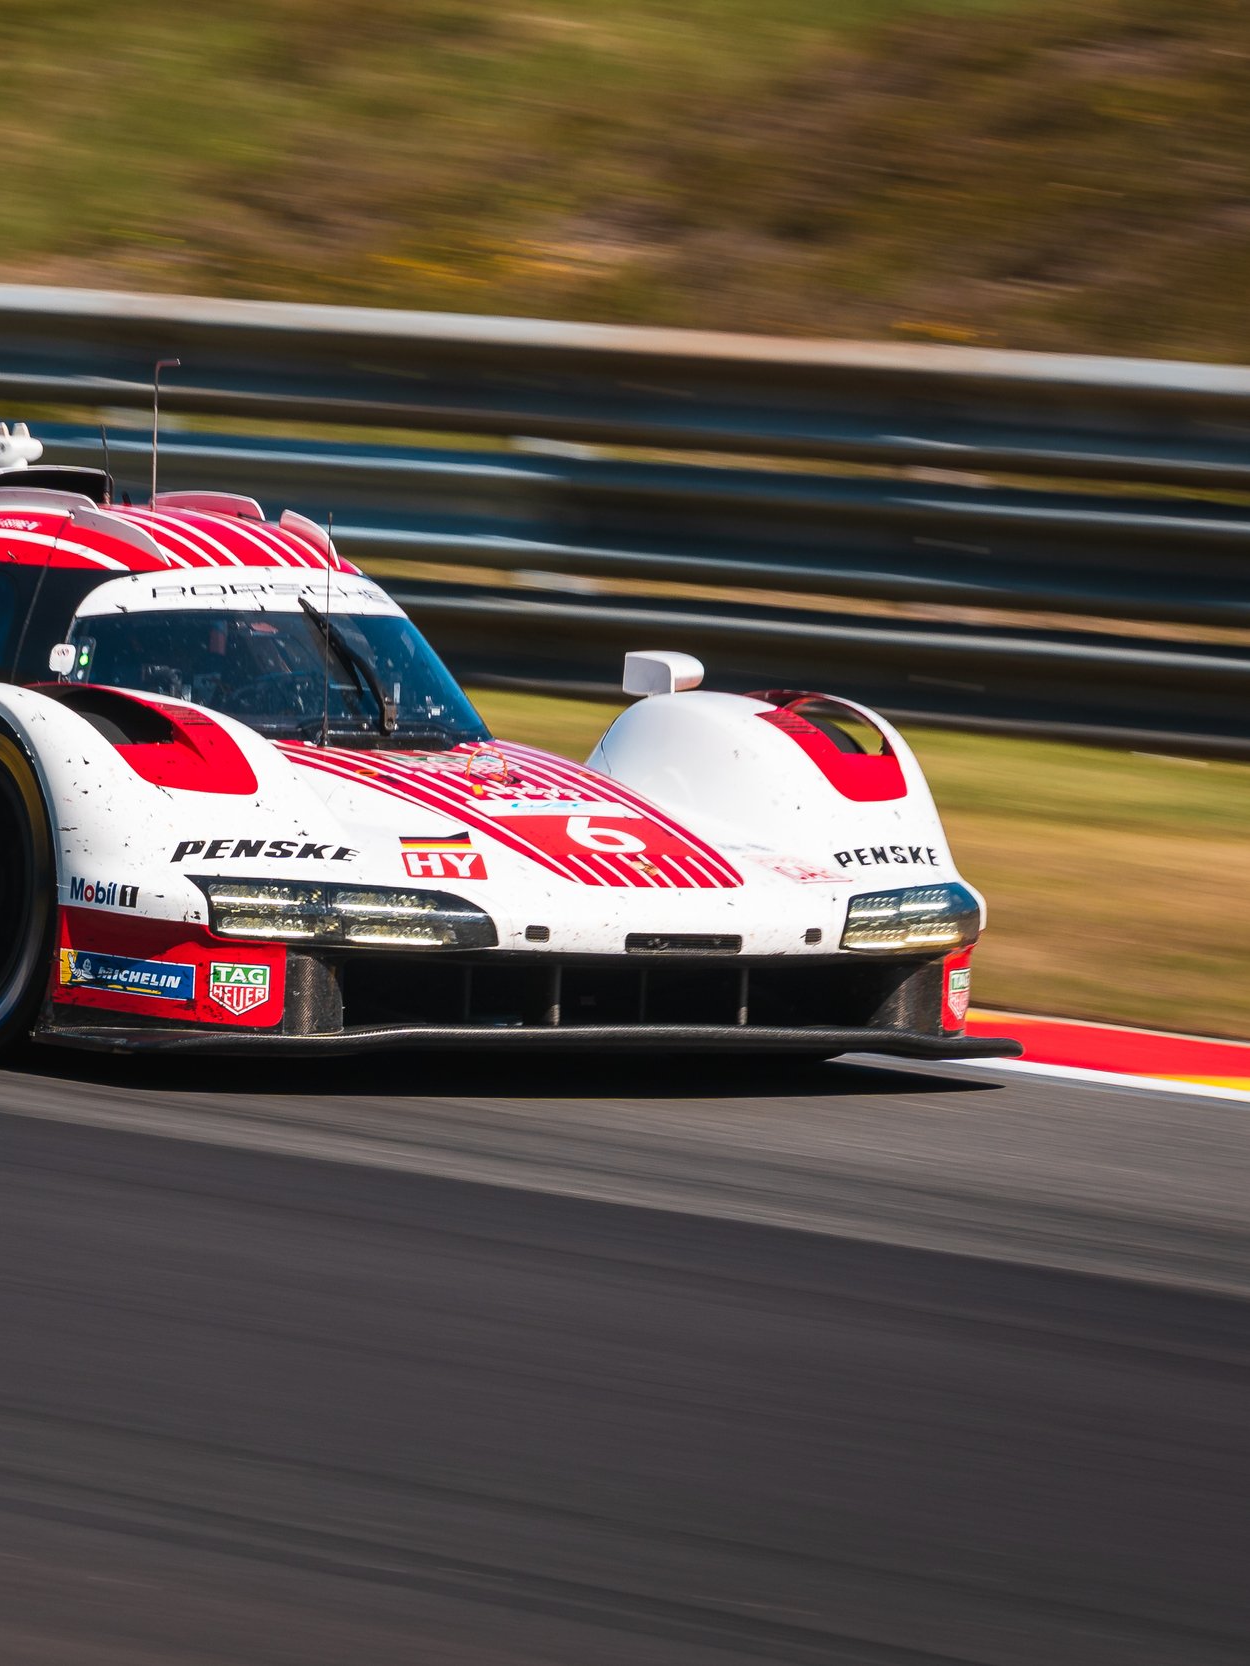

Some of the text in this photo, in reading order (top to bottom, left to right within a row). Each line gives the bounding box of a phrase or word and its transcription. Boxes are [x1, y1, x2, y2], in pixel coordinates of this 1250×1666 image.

[152, 583, 388, 605] PORSCHE
[565, 816, 648, 853] 6
[170, 839, 360, 864] PENSKE
[834, 846, 940, 868] PENSKE
[406, 853, 477, 877] HY
[70, 876, 137, 907] Mobil 1
[97, 966, 181, 989] MICHELIN
[216, 967, 265, 985] TAG
[213, 984, 267, 1011] HEUER
